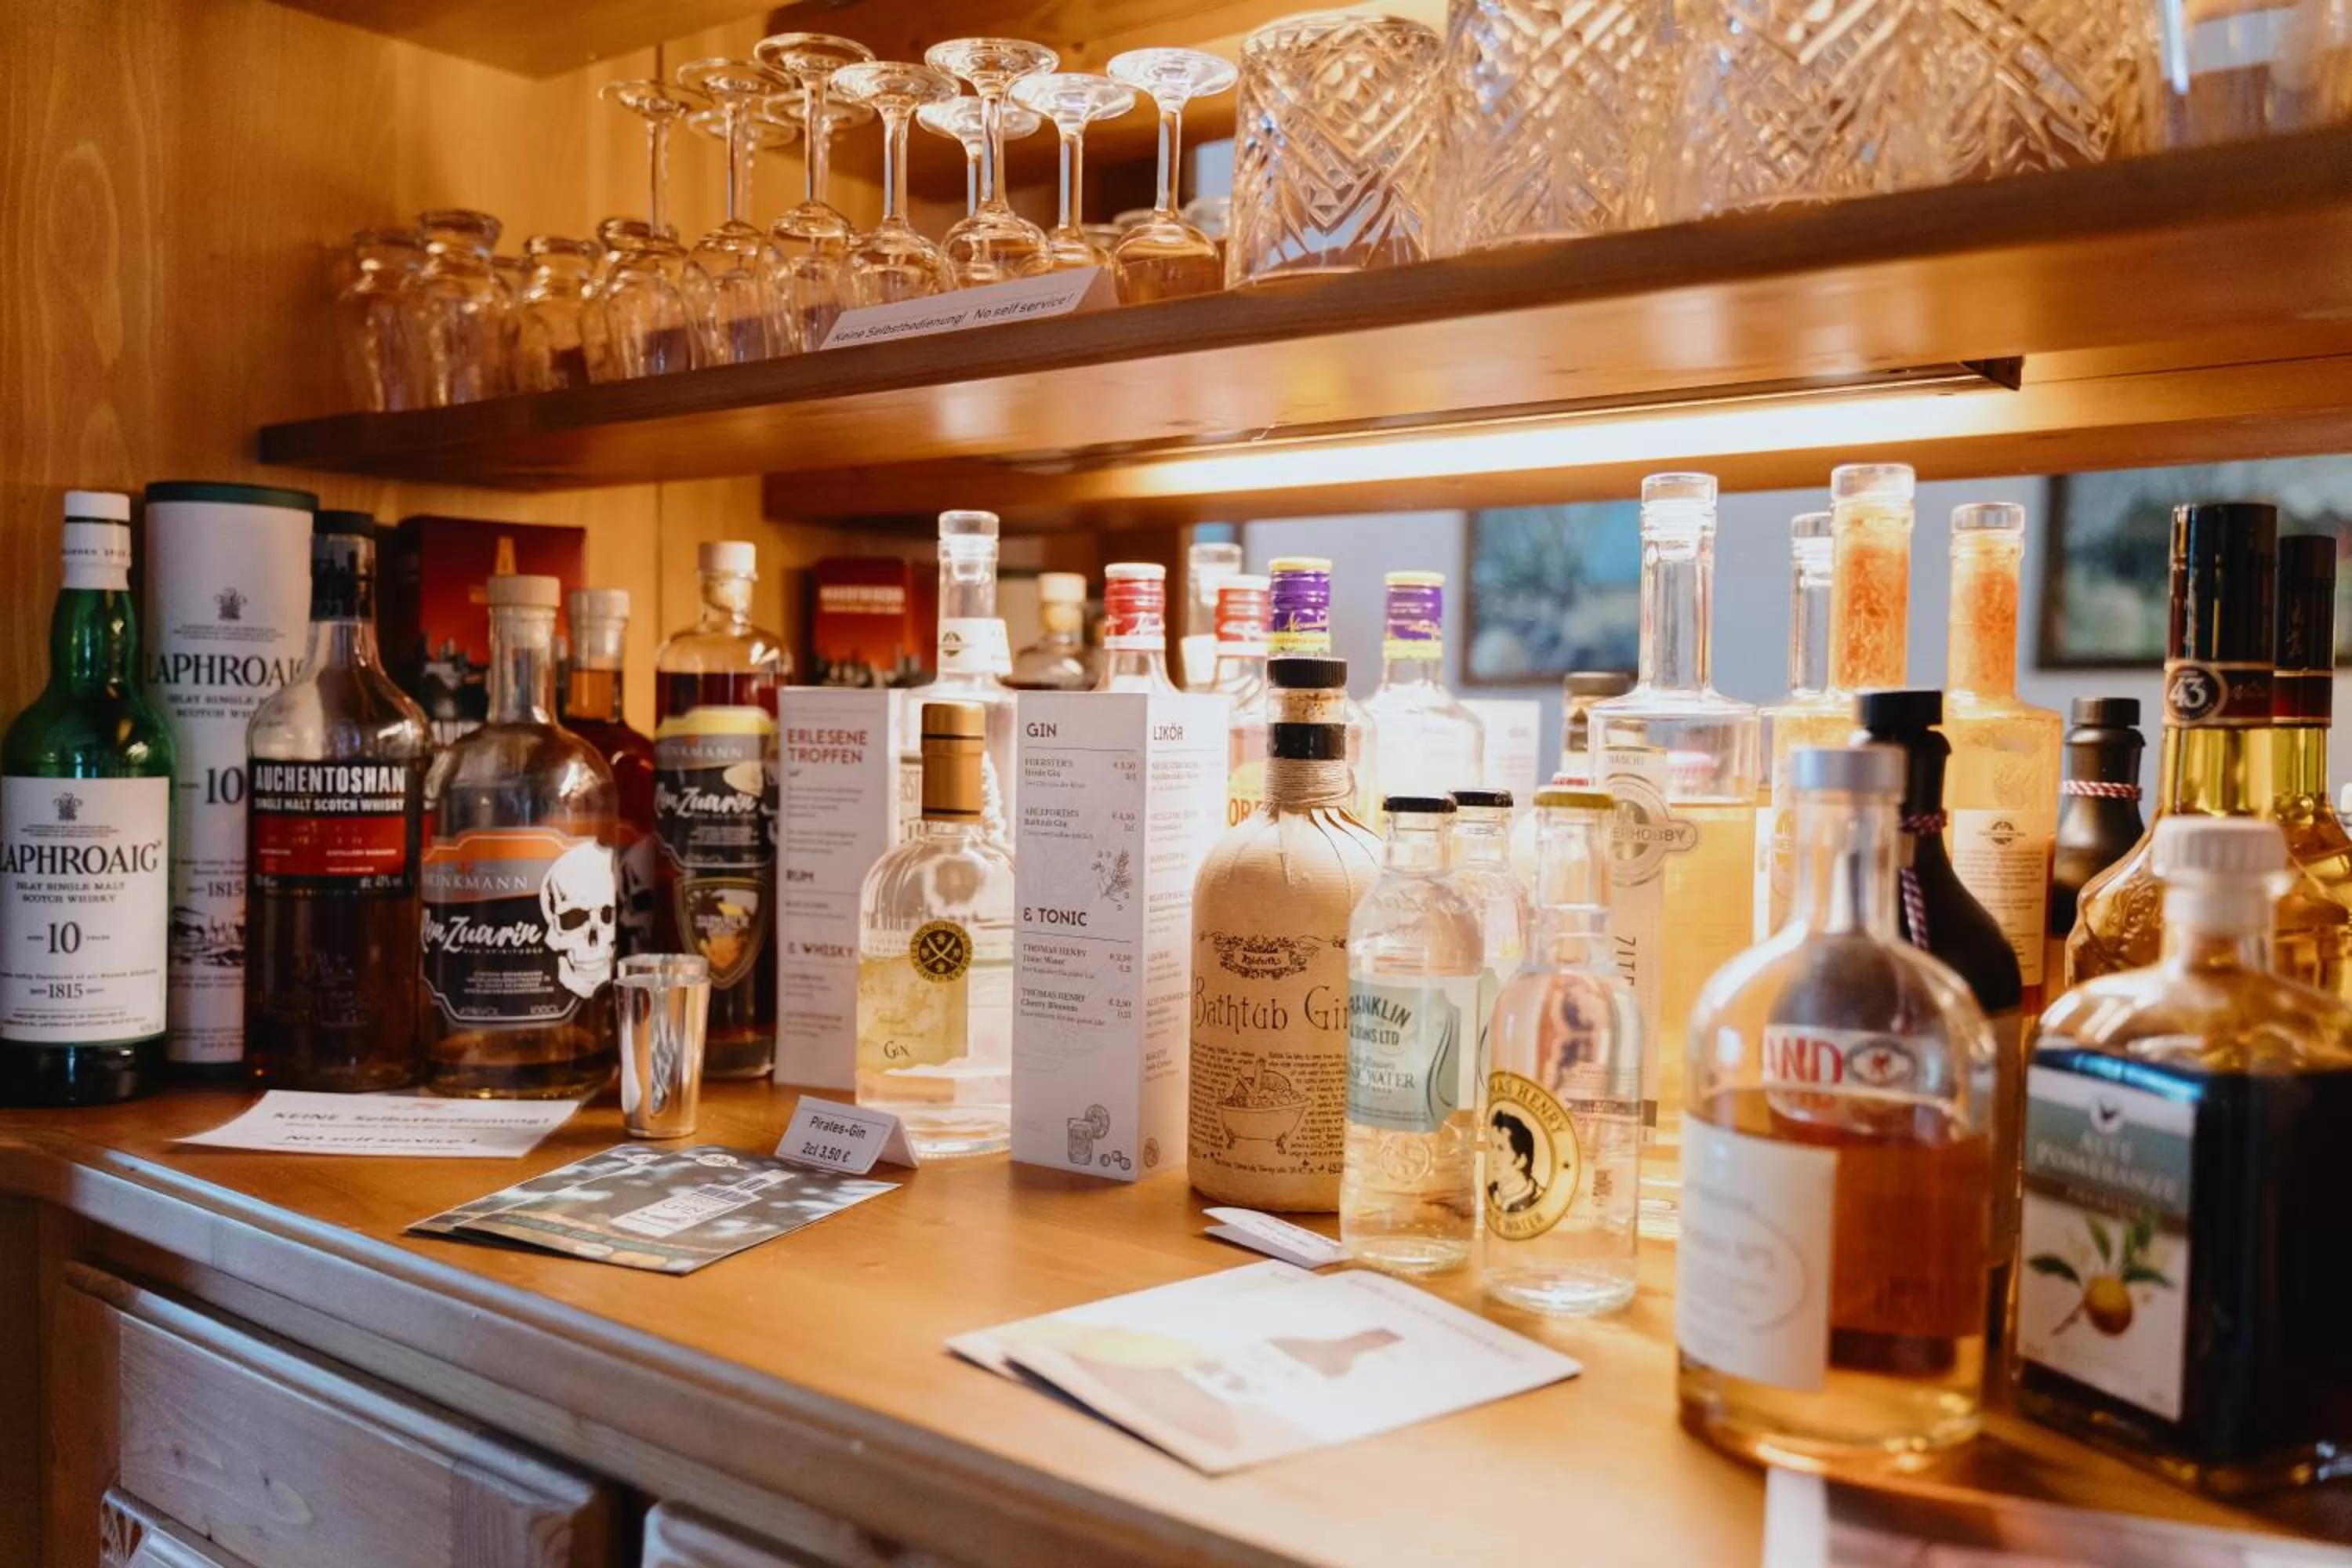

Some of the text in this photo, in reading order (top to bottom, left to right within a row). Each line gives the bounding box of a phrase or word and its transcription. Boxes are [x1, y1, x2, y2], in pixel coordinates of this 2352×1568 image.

[973, 307, 992, 320] No
[993, 302, 1019, 318] self
[2169, 676, 2208, 709] 43
[786, 728, 869, 746] ERLESENE
[1025, 721, 1058, 739] GIN
[1152, 723, 1184, 741] LIKÖR
[786, 746, 863, 765] TROPFEN
[204, 766, 245, 805] 10
[255, 764, 406, 793] AUCHENTOSHAN
[284, 797, 311, 811] MALT
[314, 798, 358, 811] SCOTCH
[360, 798, 405, 811] WHISKY
[786, 869, 815, 883] RUM
[205, 880, 245, 898] 1815
[1023, 907, 1088, 927] & TONIC
[46, 920, 82, 955] 10
[801, 942, 855, 958] WHISKY
[48, 982, 83, 1000] 1815
[1193, 976, 1289, 1035] Bathtub
[1348, 993, 1413, 1029] RANKLIN
[1379, 1029, 1400, 1046] LTD
[1517, 1083, 1568, 1134] HENRY
[808, 1115, 867, 1140] Pirates-Gin
[801, 1142, 851, 1163] 2cl 3,50 €
